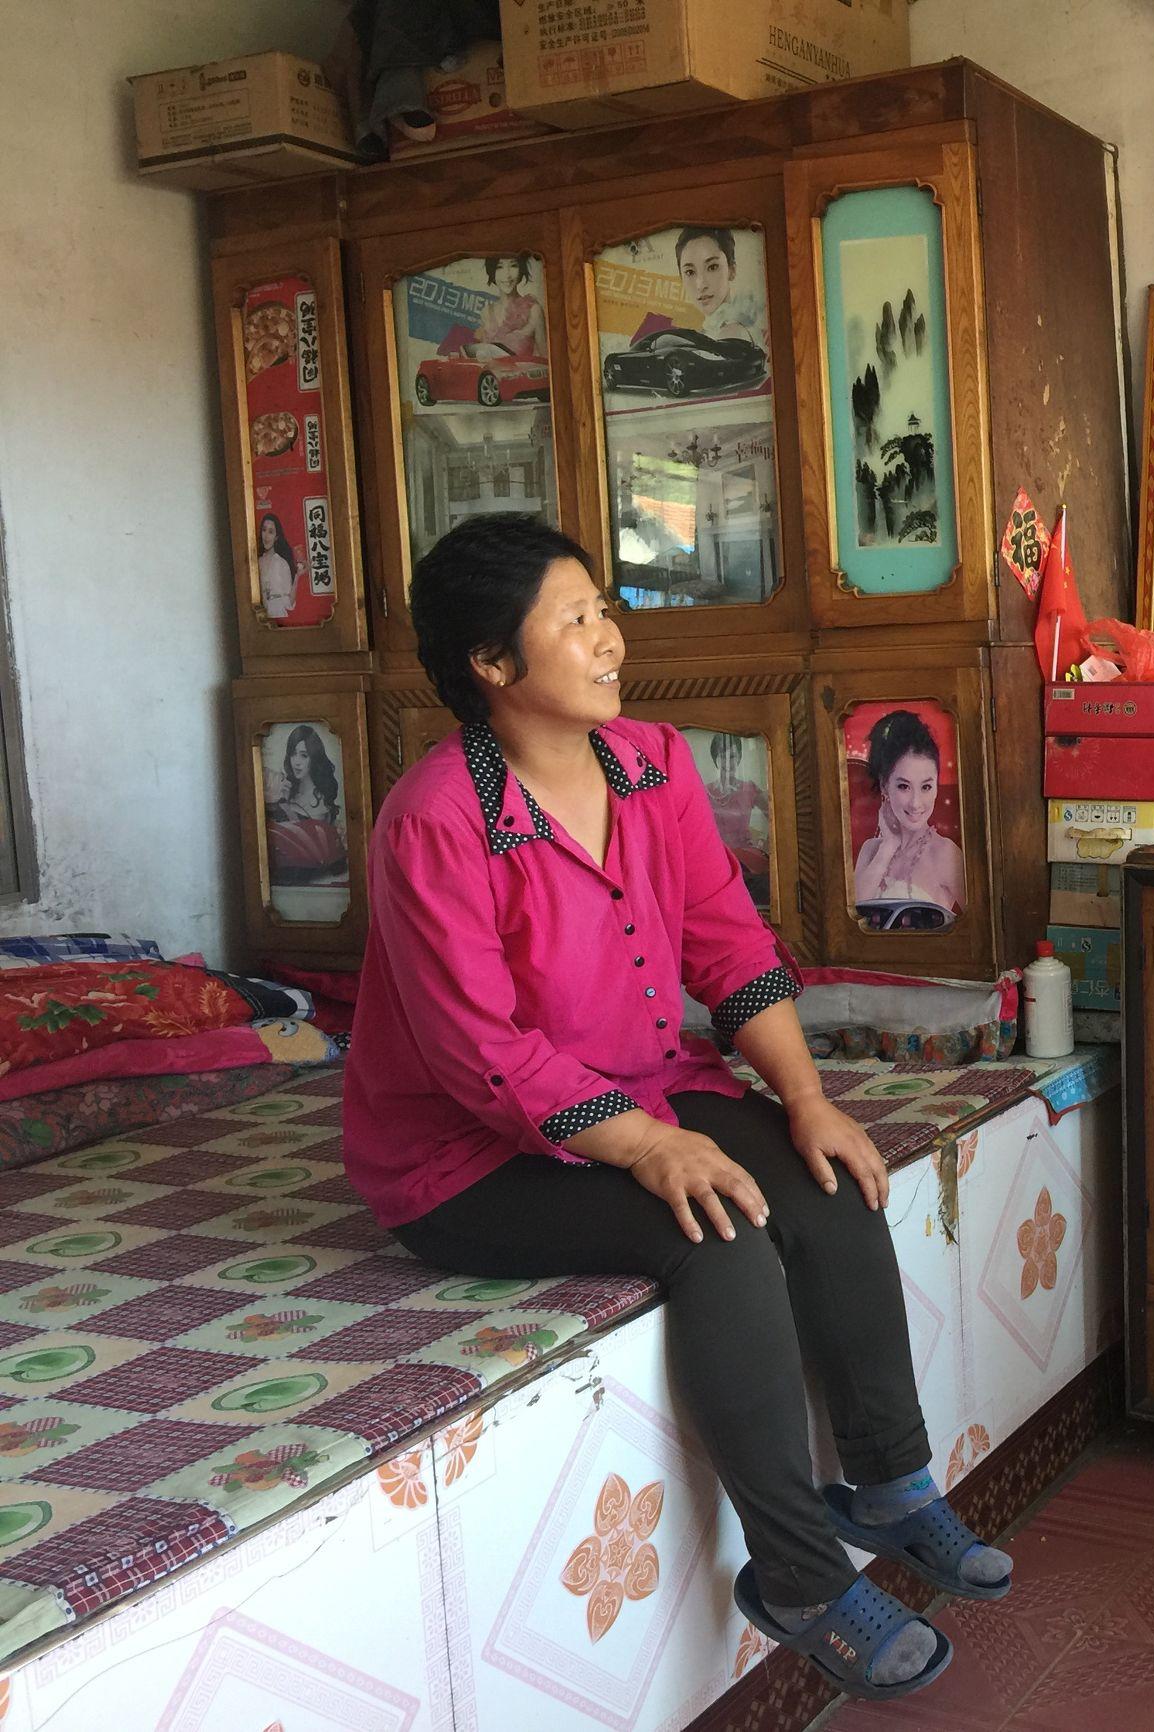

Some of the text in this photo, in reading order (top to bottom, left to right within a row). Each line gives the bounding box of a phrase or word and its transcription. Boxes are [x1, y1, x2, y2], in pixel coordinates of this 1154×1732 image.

[768, 25, 851, 79] HENGANYANHUA
[408, 276, 461, 308] 2013
[595, 267, 653, 297] 2013
[300, 300, 319, 384] 同福八宝粥
[308, 504, 331, 586] 同福八宝粥
[1011, 509, 1042, 572] 福
[828, 1631, 857, 1661] VIP
